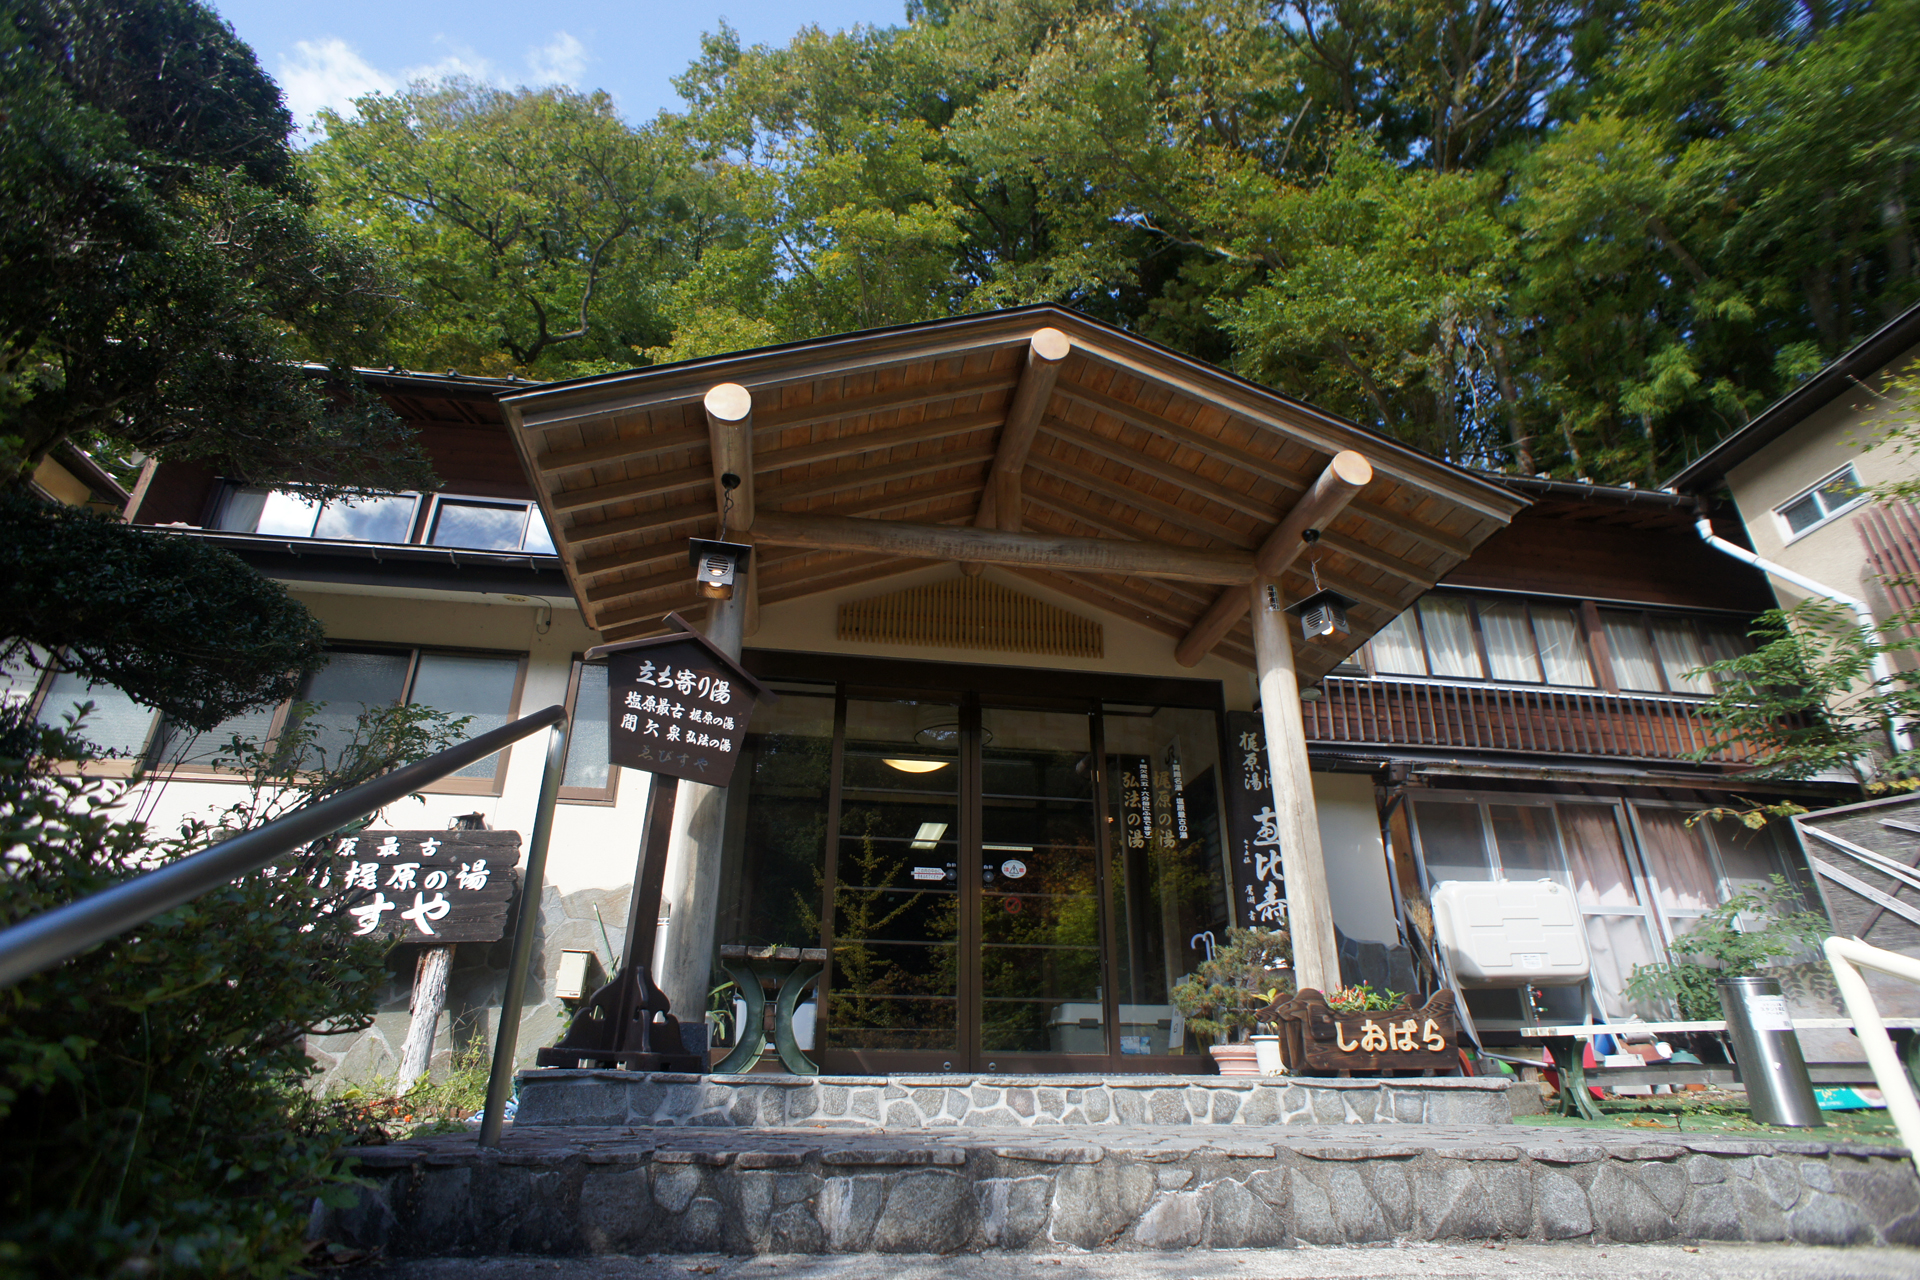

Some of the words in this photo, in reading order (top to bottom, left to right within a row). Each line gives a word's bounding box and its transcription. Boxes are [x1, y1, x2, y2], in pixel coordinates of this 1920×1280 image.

[636, 660, 731, 705] 立ち寄り湯
[624, 691, 685, 720] 塩原最古
[689, 707, 735, 731] 梶原の湯
[685, 730, 732, 753] 弘法の湯
[1239, 731, 1262, 791] 梶原湯
[1122, 771, 1145, 849] 弘法の湯
[1153, 771, 1176, 848] 梶原の湯
[344, 859, 491, 891] 梶原の湯
[1334, 1018, 1446, 1052] しおばら
